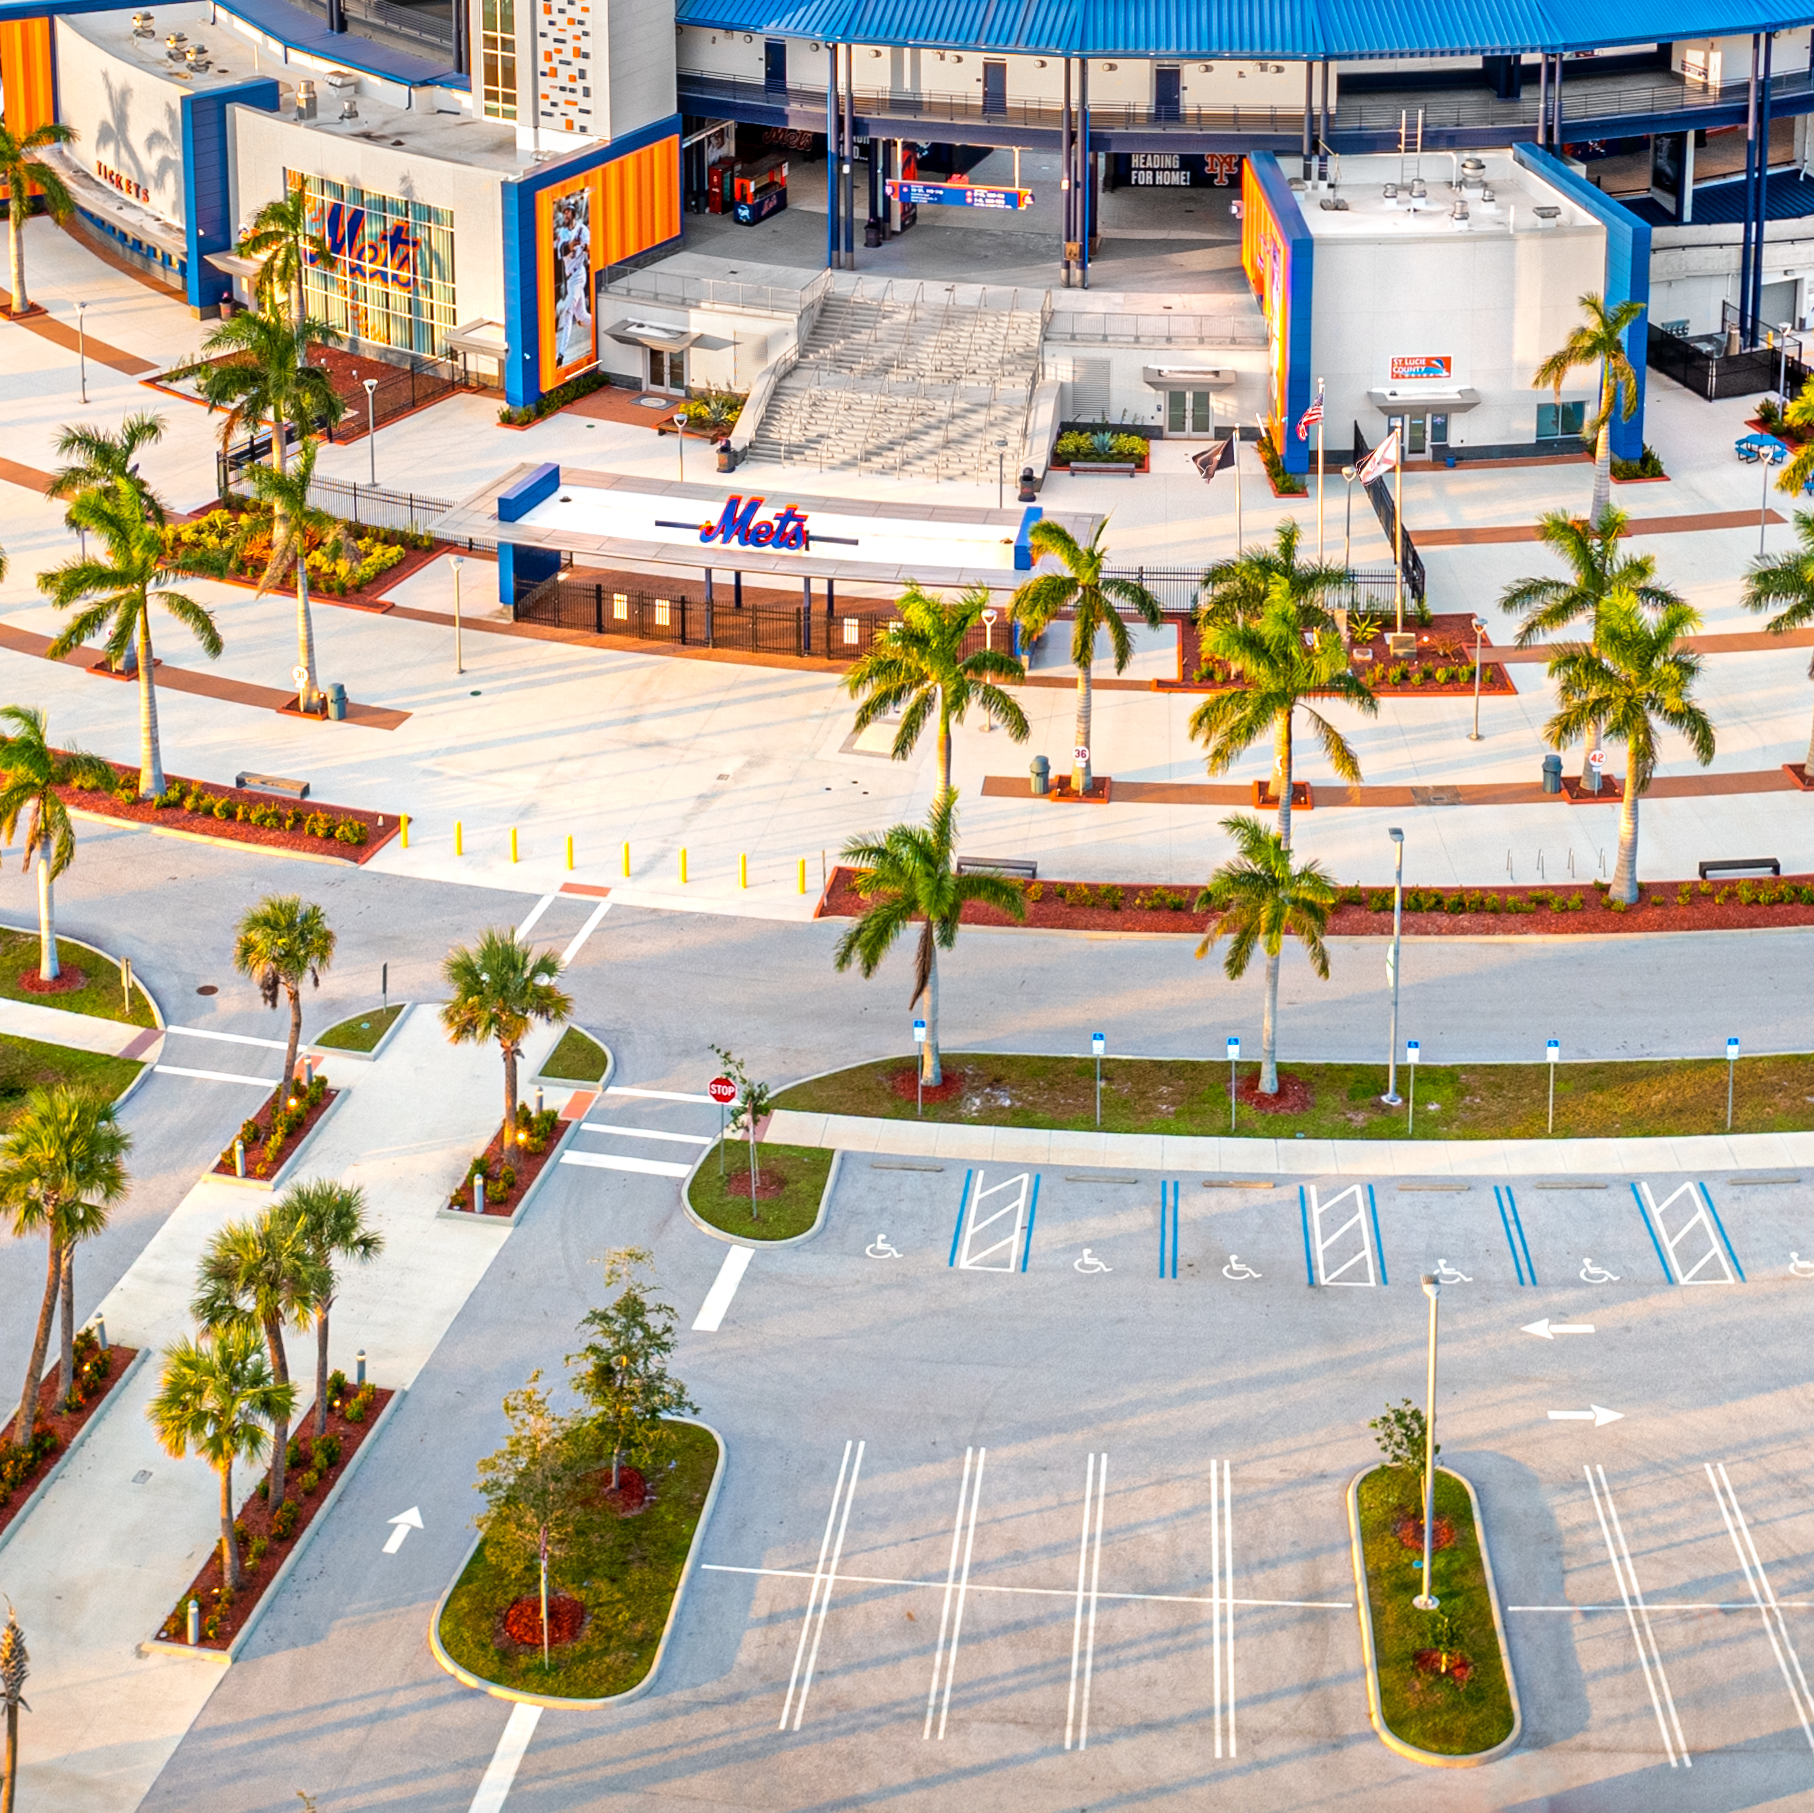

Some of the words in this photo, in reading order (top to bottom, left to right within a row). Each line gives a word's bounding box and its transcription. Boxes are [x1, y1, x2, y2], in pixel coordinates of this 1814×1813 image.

[762, 126, 813, 152] Mets
[1131, 153, 1180, 169] HEADING
[96, 159, 151, 204] TICKETS
[1131, 170, 1155, 186] FOR
[1155, 170, 1191, 186] HOME!
[303, 200, 421, 291] Mets
[1393, 366, 1426, 374] COUNTY
[1405, 358, 1426, 366] LUCIE
[698, 494, 810, 552] Mets
[1074, 748, 1087, 758] 36
[1590, 753, 1604, 763] 42
[710, 1086, 735, 1097] STOP
